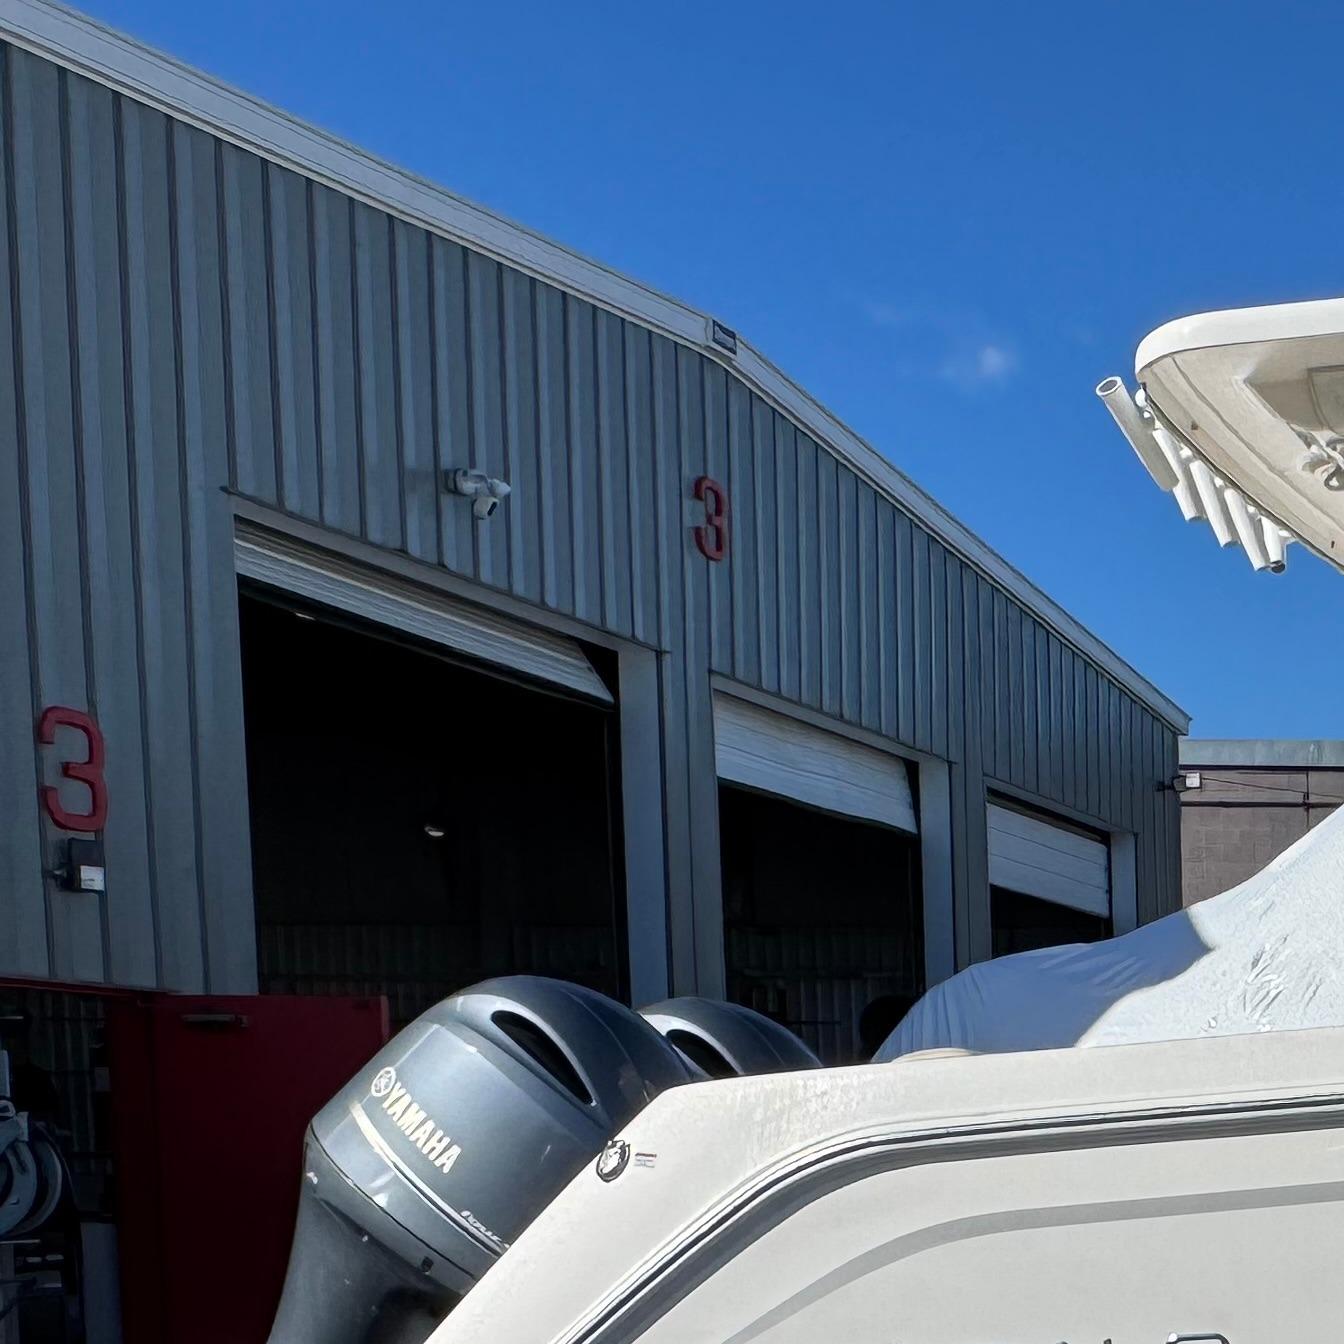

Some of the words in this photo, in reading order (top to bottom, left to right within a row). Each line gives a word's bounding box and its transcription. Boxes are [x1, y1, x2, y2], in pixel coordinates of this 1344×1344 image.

[693, 476, 724, 562] 3
[39, 706, 108, 832] 3
[381, 1081, 462, 1174] YAMAHA
